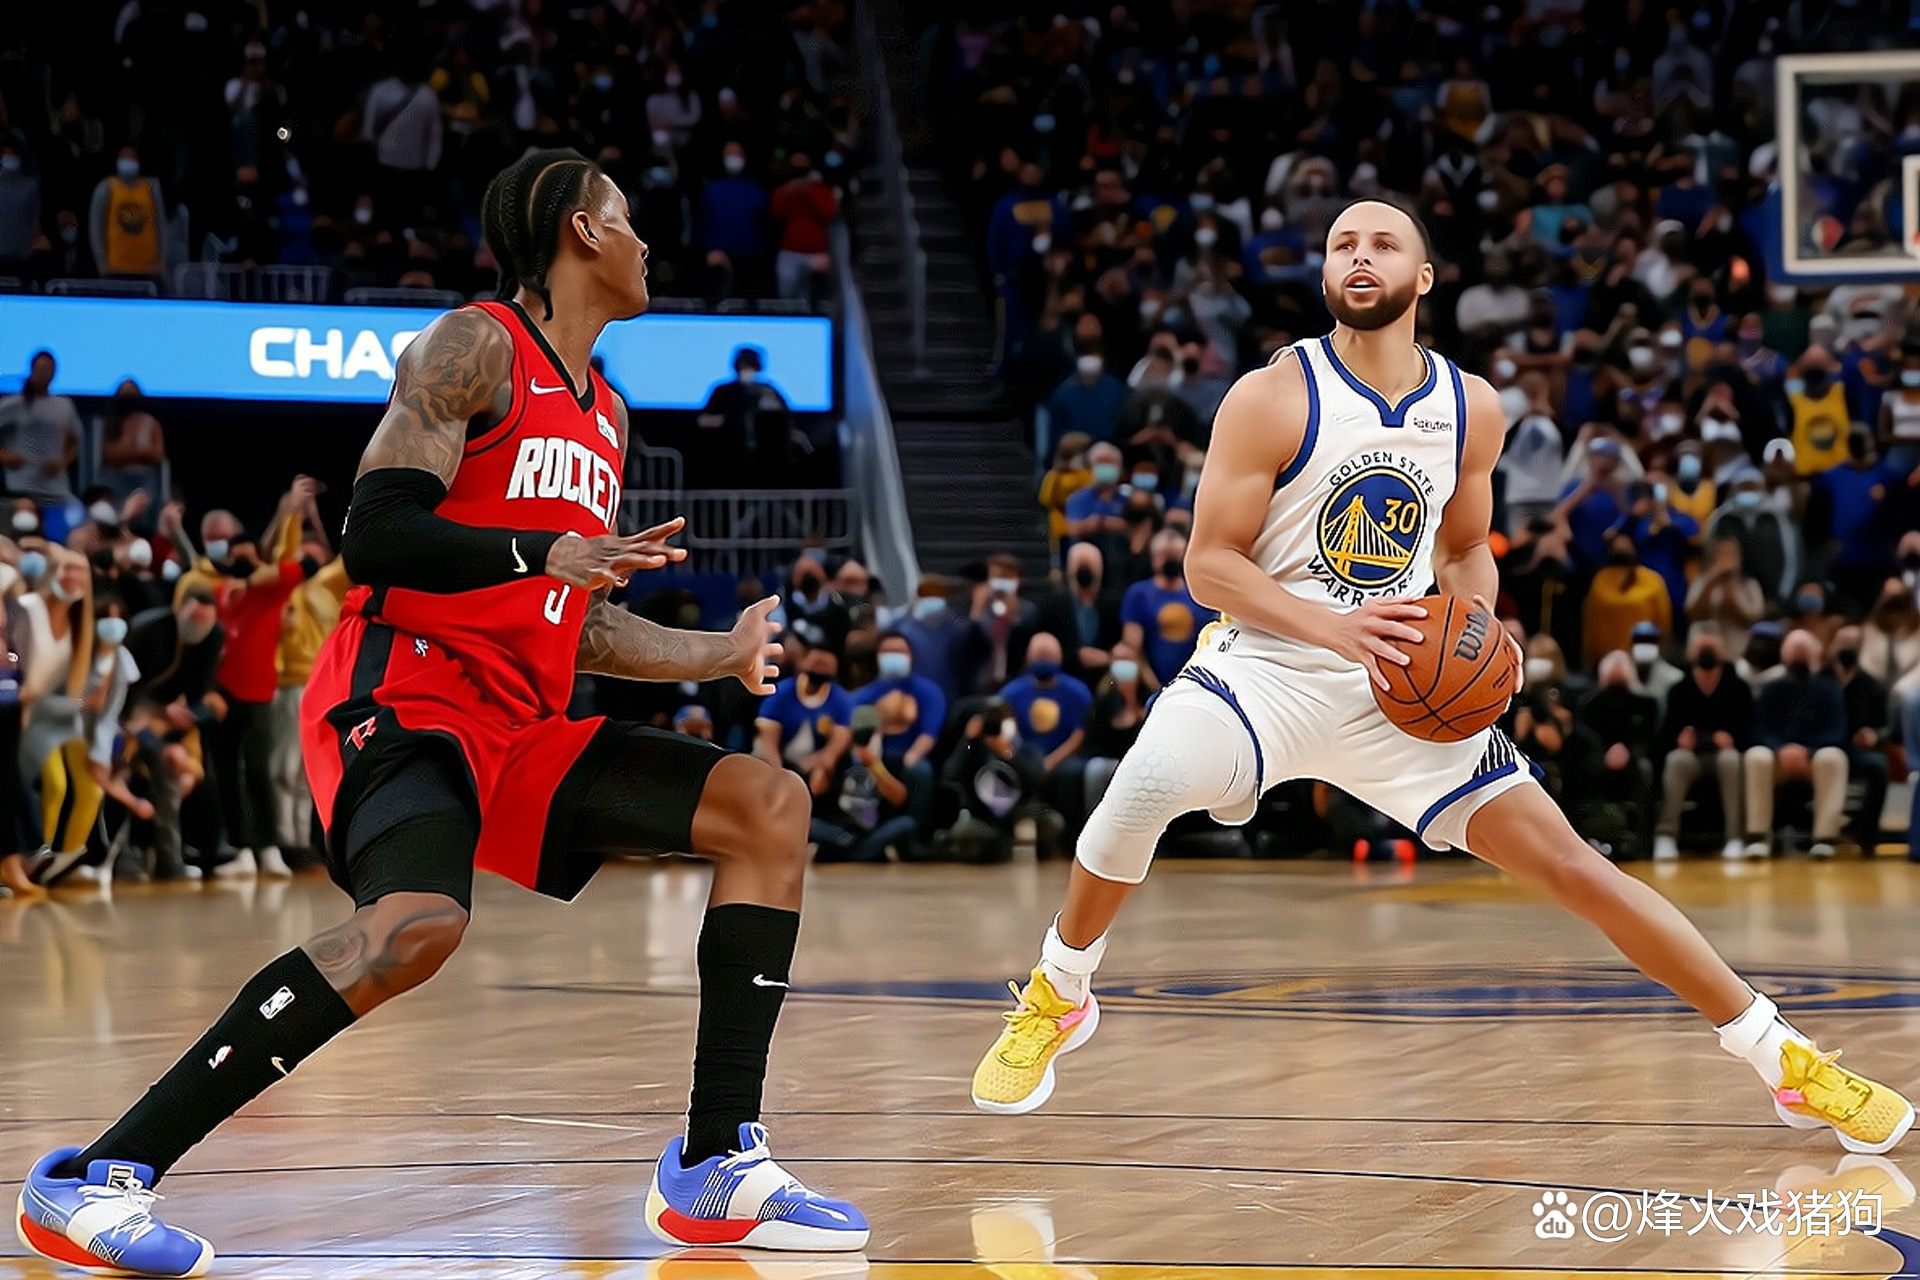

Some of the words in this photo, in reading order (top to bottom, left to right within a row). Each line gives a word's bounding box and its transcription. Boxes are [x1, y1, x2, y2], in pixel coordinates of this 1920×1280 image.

[1329, 451, 1393, 486] GOLDEN
[1399, 456, 1434, 497] STATE
[1379, 498, 1419, 534] 30
